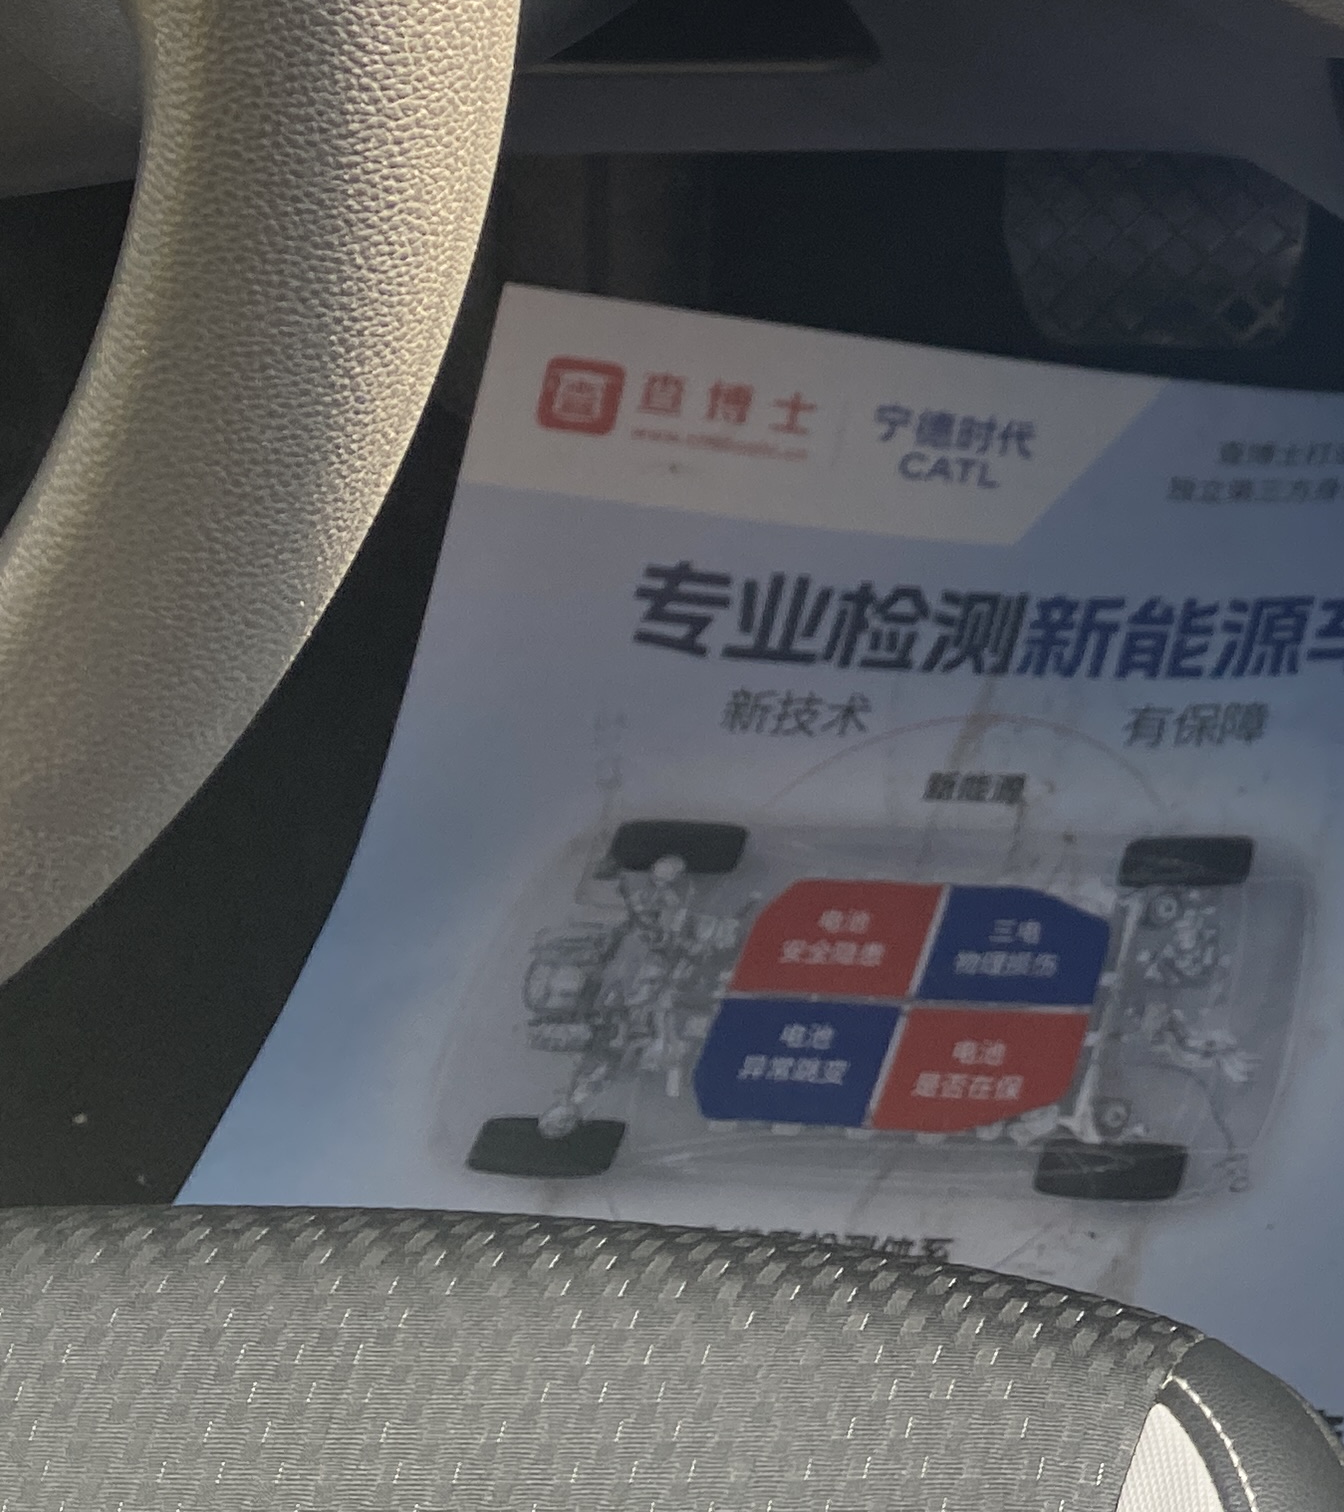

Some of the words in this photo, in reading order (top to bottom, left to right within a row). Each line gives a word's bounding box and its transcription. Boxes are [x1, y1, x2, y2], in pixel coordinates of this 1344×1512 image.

[898, 451, 1001, 490] CATL
[719, 687, 874, 738] 新技术
[1123, 700, 1271, 749] 有保障
